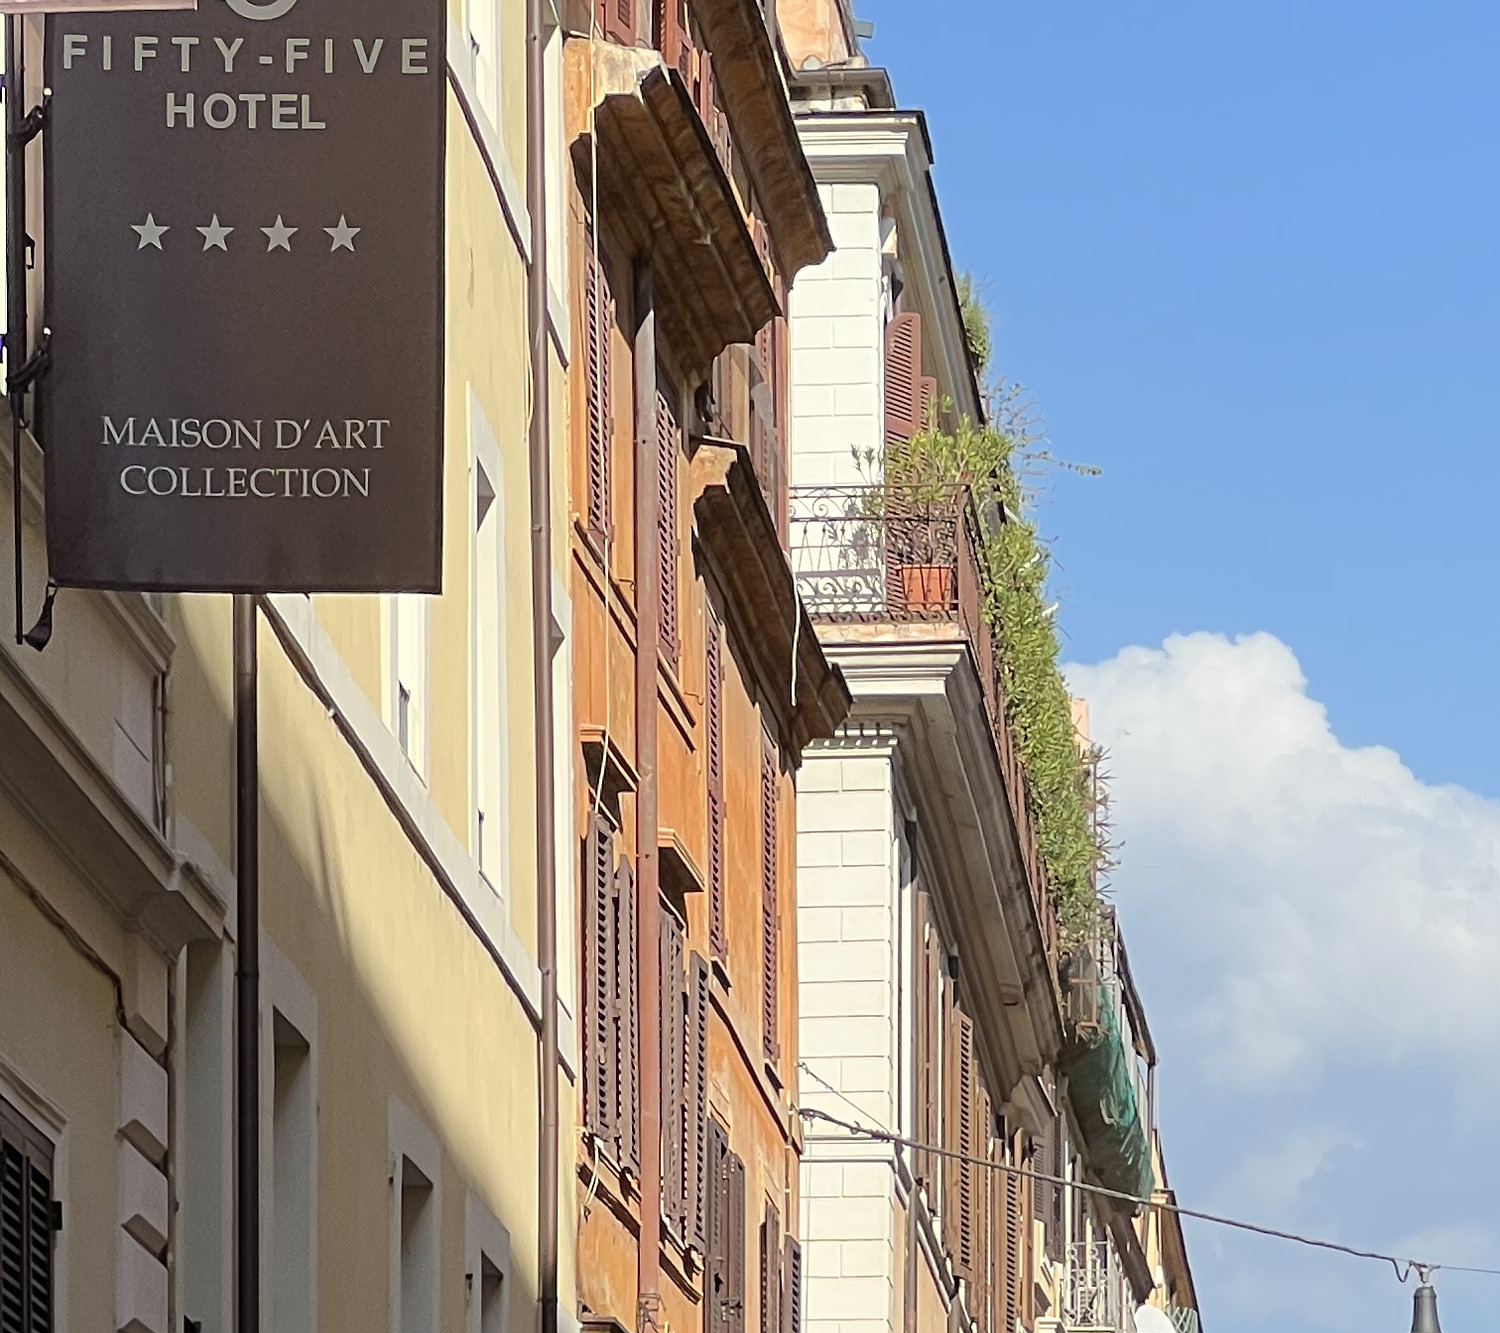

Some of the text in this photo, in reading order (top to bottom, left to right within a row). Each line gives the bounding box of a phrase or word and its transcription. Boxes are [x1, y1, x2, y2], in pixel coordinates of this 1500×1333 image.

[63, 34, 430, 75] FIFTY-FIVE
[165, 92, 326, 131] HOTEL
[100, 415, 391, 449] MAISON D'ART
[119, 465, 372, 498] COLLECTION
